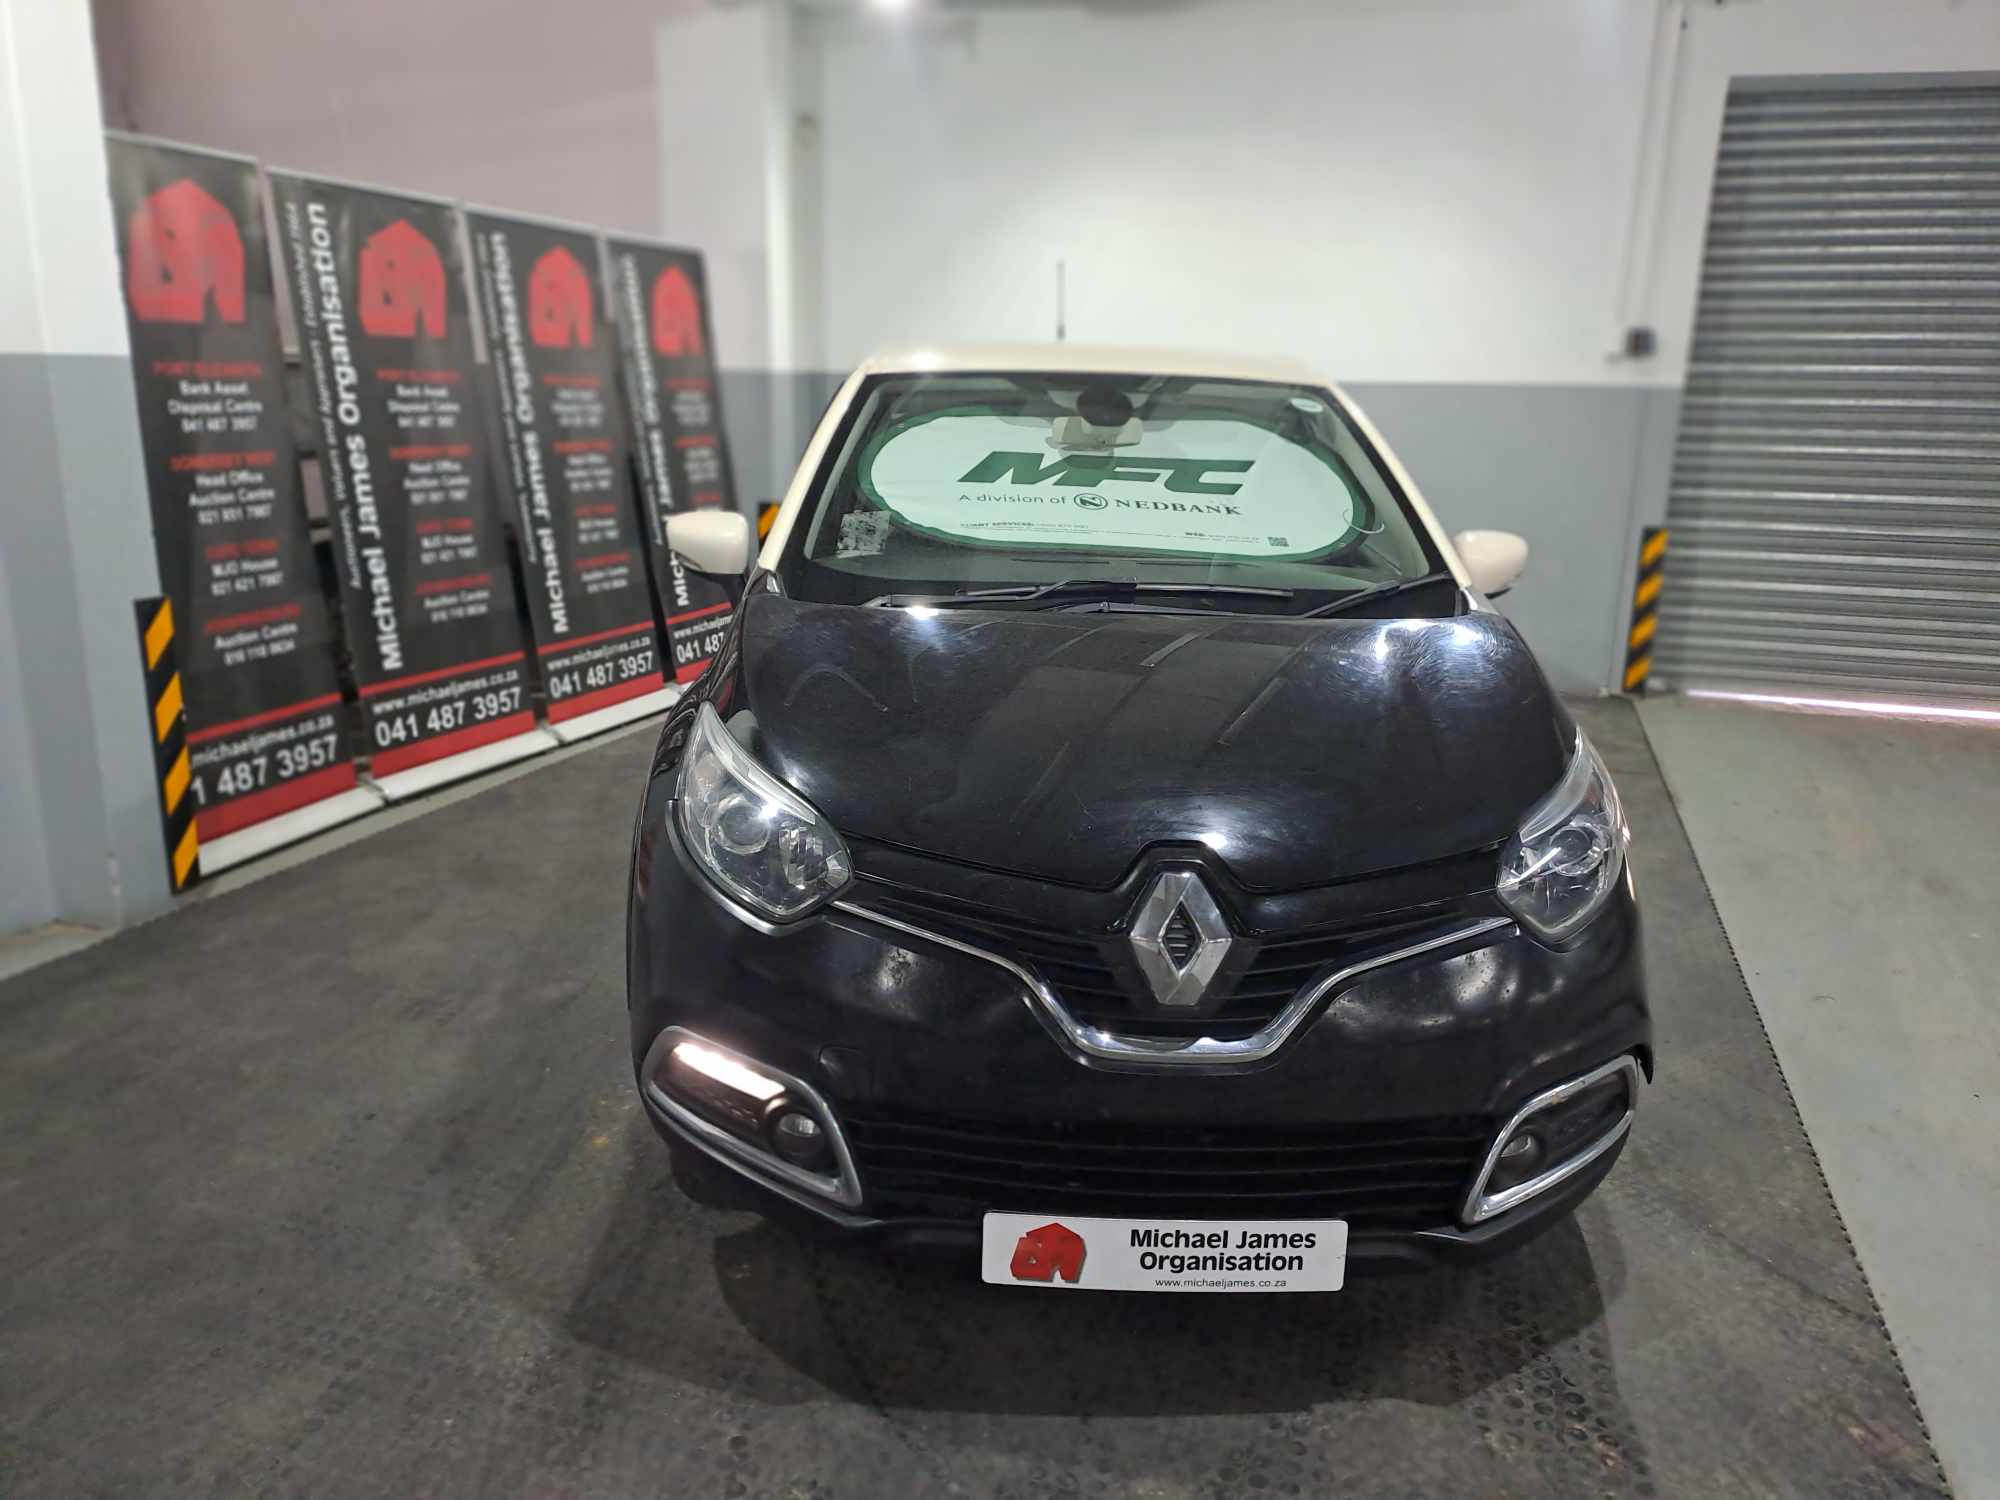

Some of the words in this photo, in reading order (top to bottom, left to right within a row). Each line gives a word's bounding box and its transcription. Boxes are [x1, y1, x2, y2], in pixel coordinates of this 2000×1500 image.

[346, 434, 383, 539] James
[521, 430, 552, 521] James
[957, 450, 1256, 495] MFC
[959, 494, 971, 504] A
[976, 493, 1043, 506] division
[1050, 494, 1066, 506] of
[1115, 499, 1243, 516] NEDBANK
[536, 527, 569, 634] Michael
[362, 548, 403, 670] Michael
[547, 636, 652, 671] www.michaeljames.co.za
[549, 671, 582, 699] 041
[586, 661, 614, 688] 487
[618, 651, 654, 680] 3957
[676, 640, 701, 664] 041
[372, 668, 520, 716] www.michaeljames.co.za
[374, 713, 419, 748] 041
[427, 701, 466, 732] 487
[474, 686, 523, 720] 3957
[216, 757, 268, 796] 487
[276, 735, 339, 778] 3957
[1130, 1228, 1230, 1249] Michael
[1235, 1229, 1317, 1250] James
[1139, 1251, 1304, 1273] Organisation
[1155, 1278, 1288, 1290] www.michaeljames.co.za
